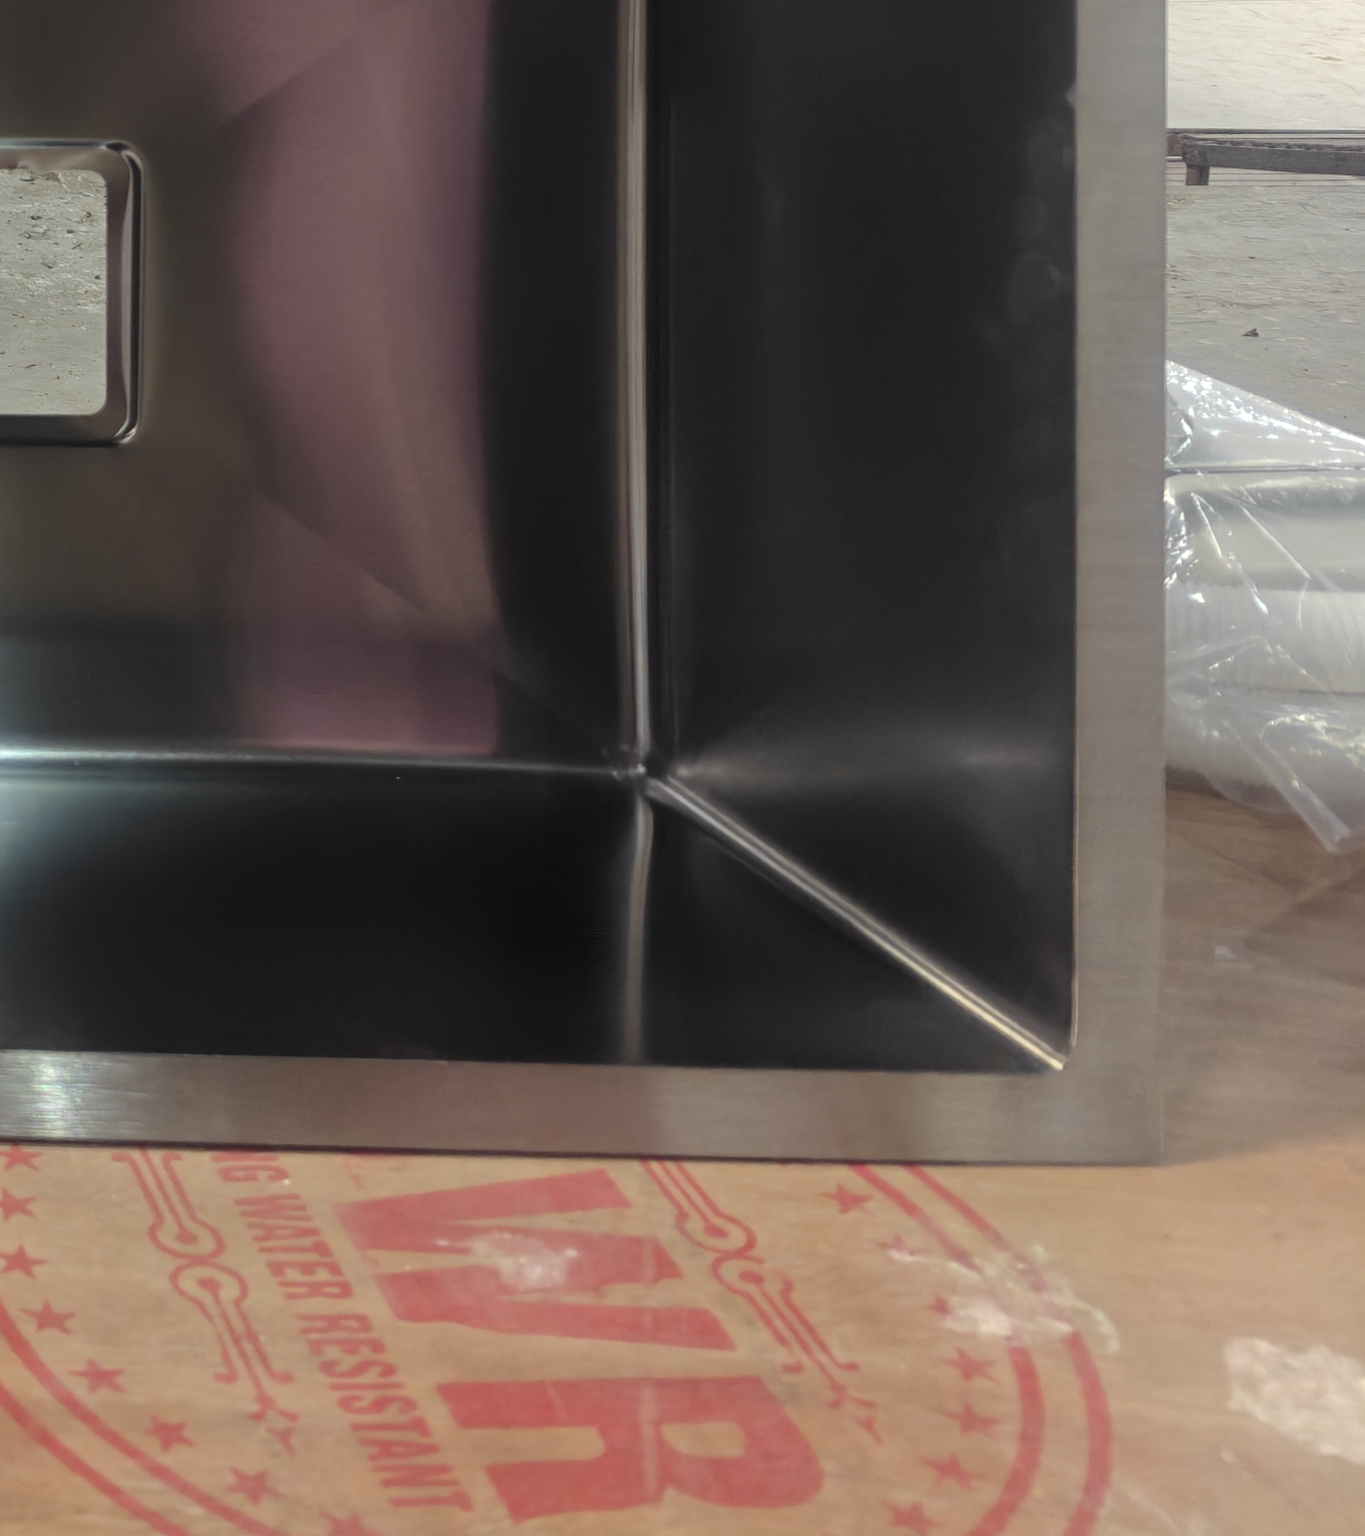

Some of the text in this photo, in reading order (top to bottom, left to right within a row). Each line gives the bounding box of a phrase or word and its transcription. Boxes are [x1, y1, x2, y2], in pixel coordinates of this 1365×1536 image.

[234, 1193, 354, 1299] WATER
[294, 1313, 475, 1512] RESISTANT
[331, 1169, 826, 1526] WR
